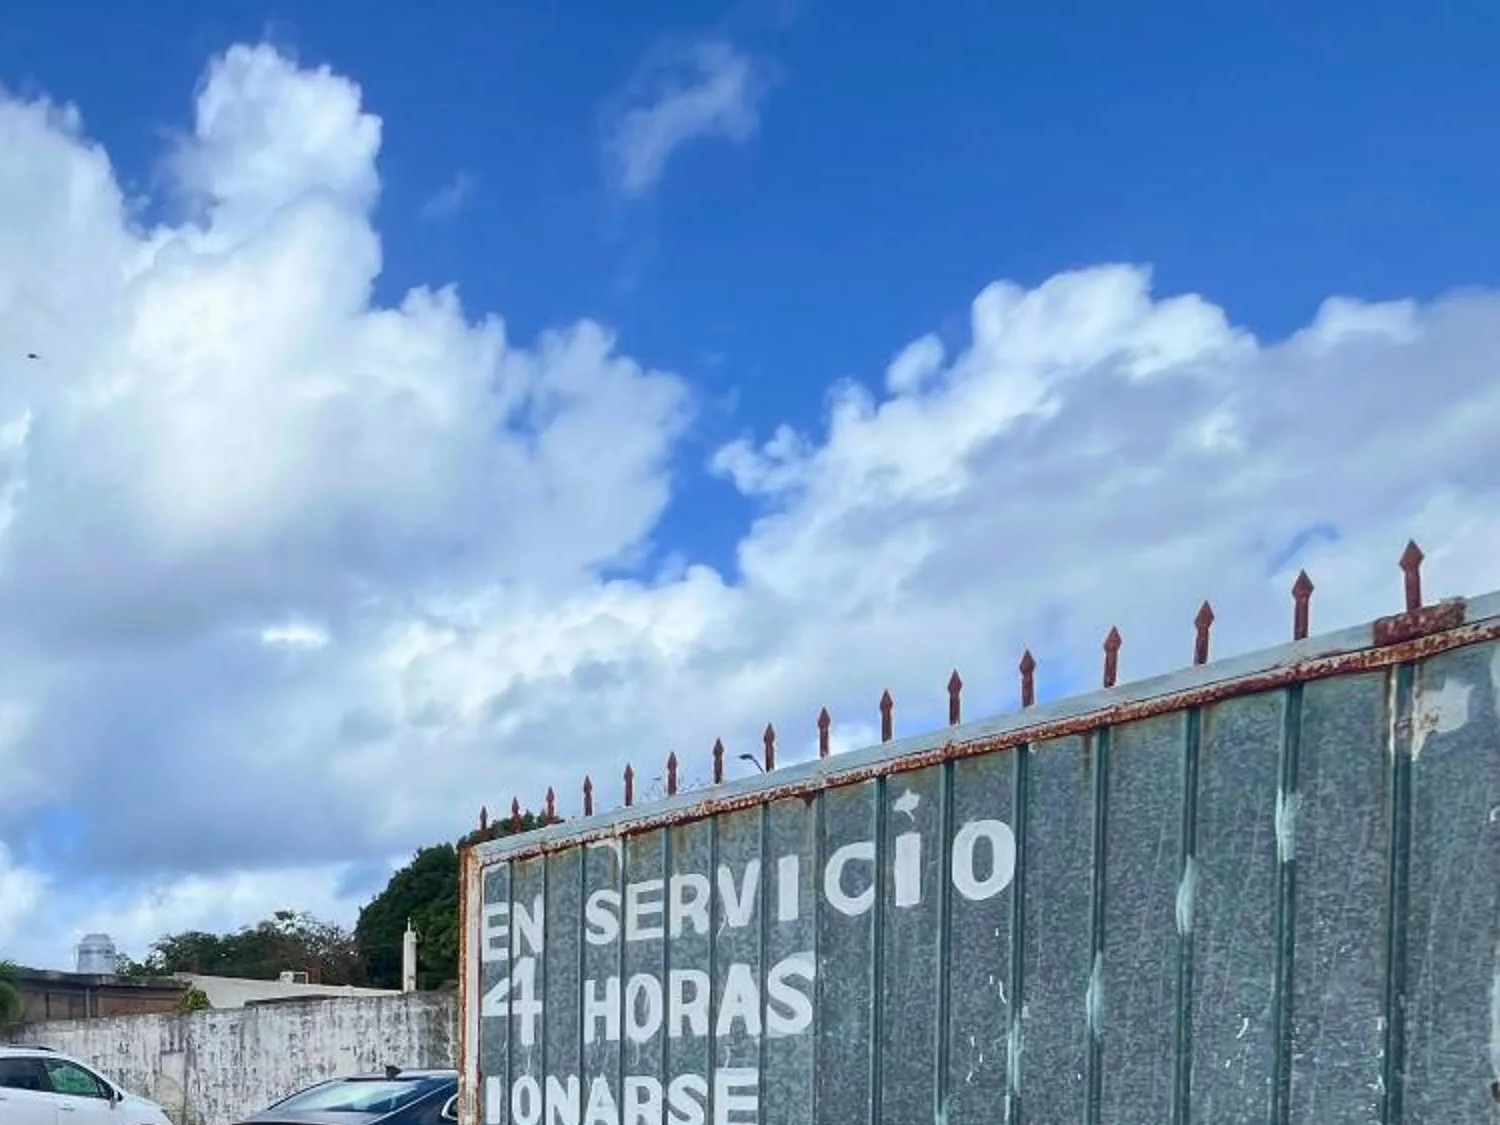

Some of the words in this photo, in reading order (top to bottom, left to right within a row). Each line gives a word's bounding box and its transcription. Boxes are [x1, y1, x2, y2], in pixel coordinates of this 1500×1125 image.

[481, 894, 544, 962] EN
[585, 790, 1017, 945] SERVICIO
[481, 957, 543, 1046] 4
[584, 950, 817, 1046] HORAS
